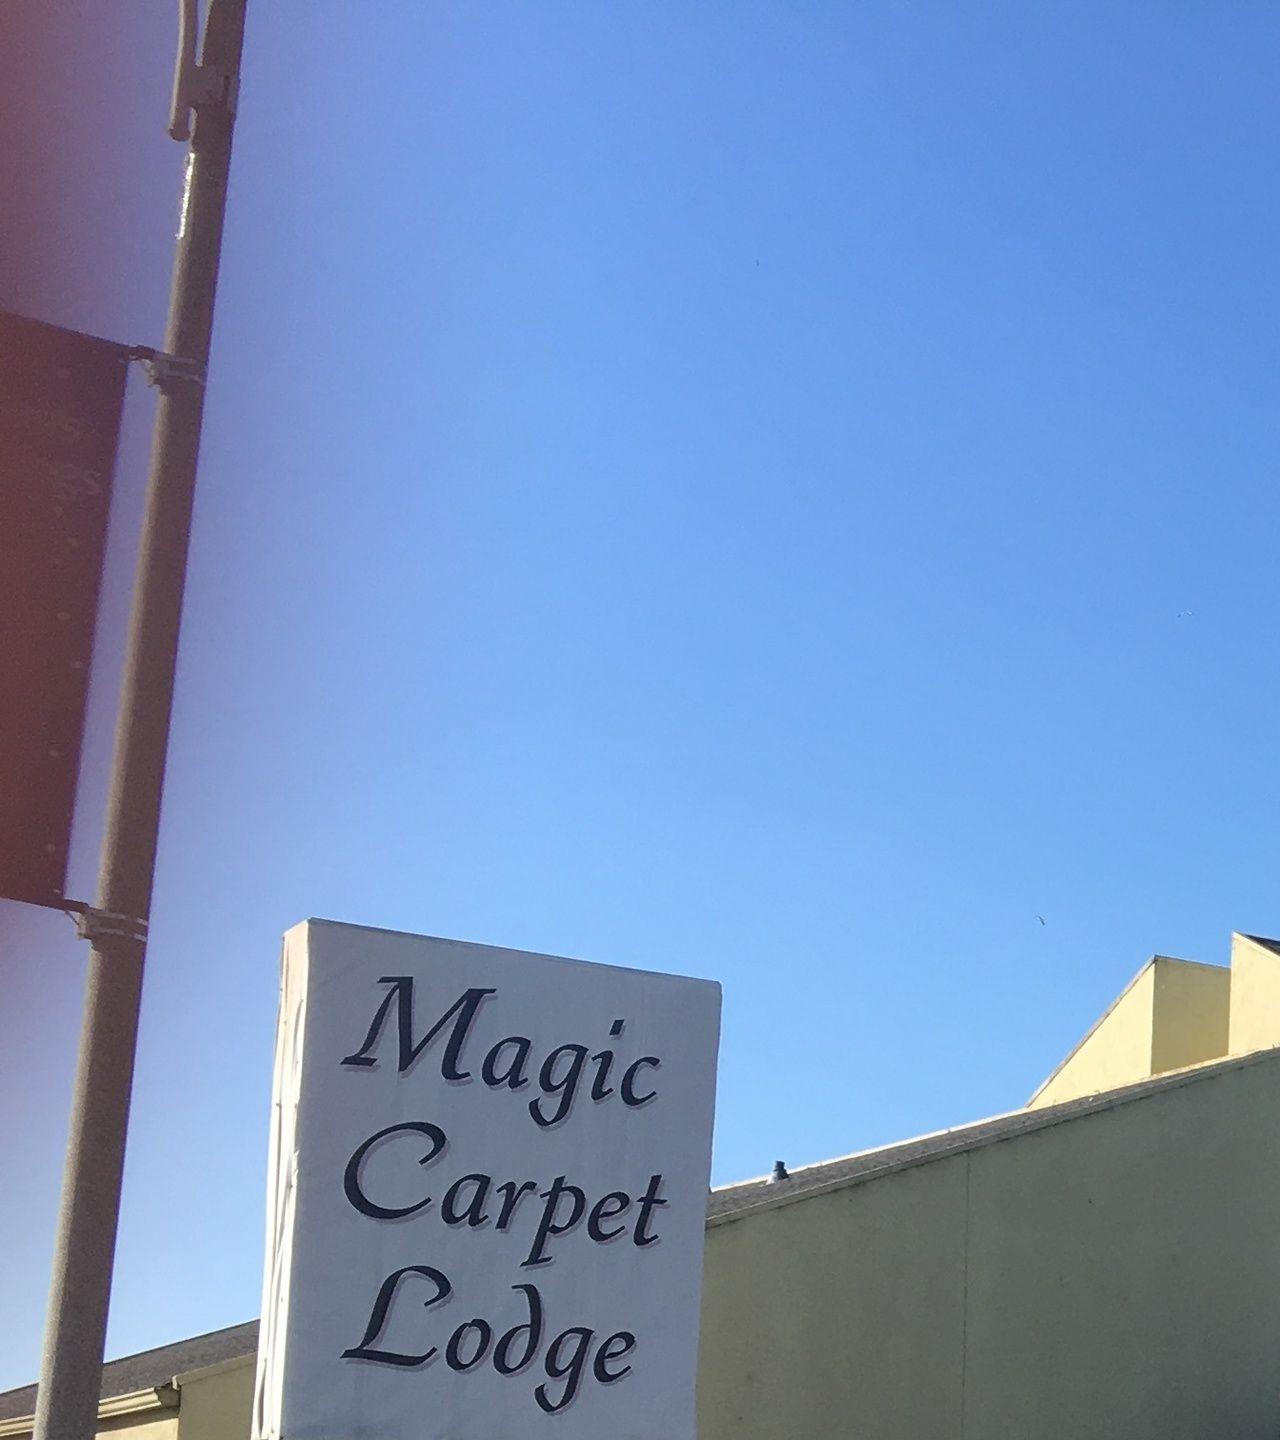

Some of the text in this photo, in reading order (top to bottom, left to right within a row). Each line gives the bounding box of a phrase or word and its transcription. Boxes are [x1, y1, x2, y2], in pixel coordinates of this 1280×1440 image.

[340, 976, 662, 1127] Magic
[343, 1121, 668, 1267] Carpet
[340, 1264, 636, 1413] Lodge
